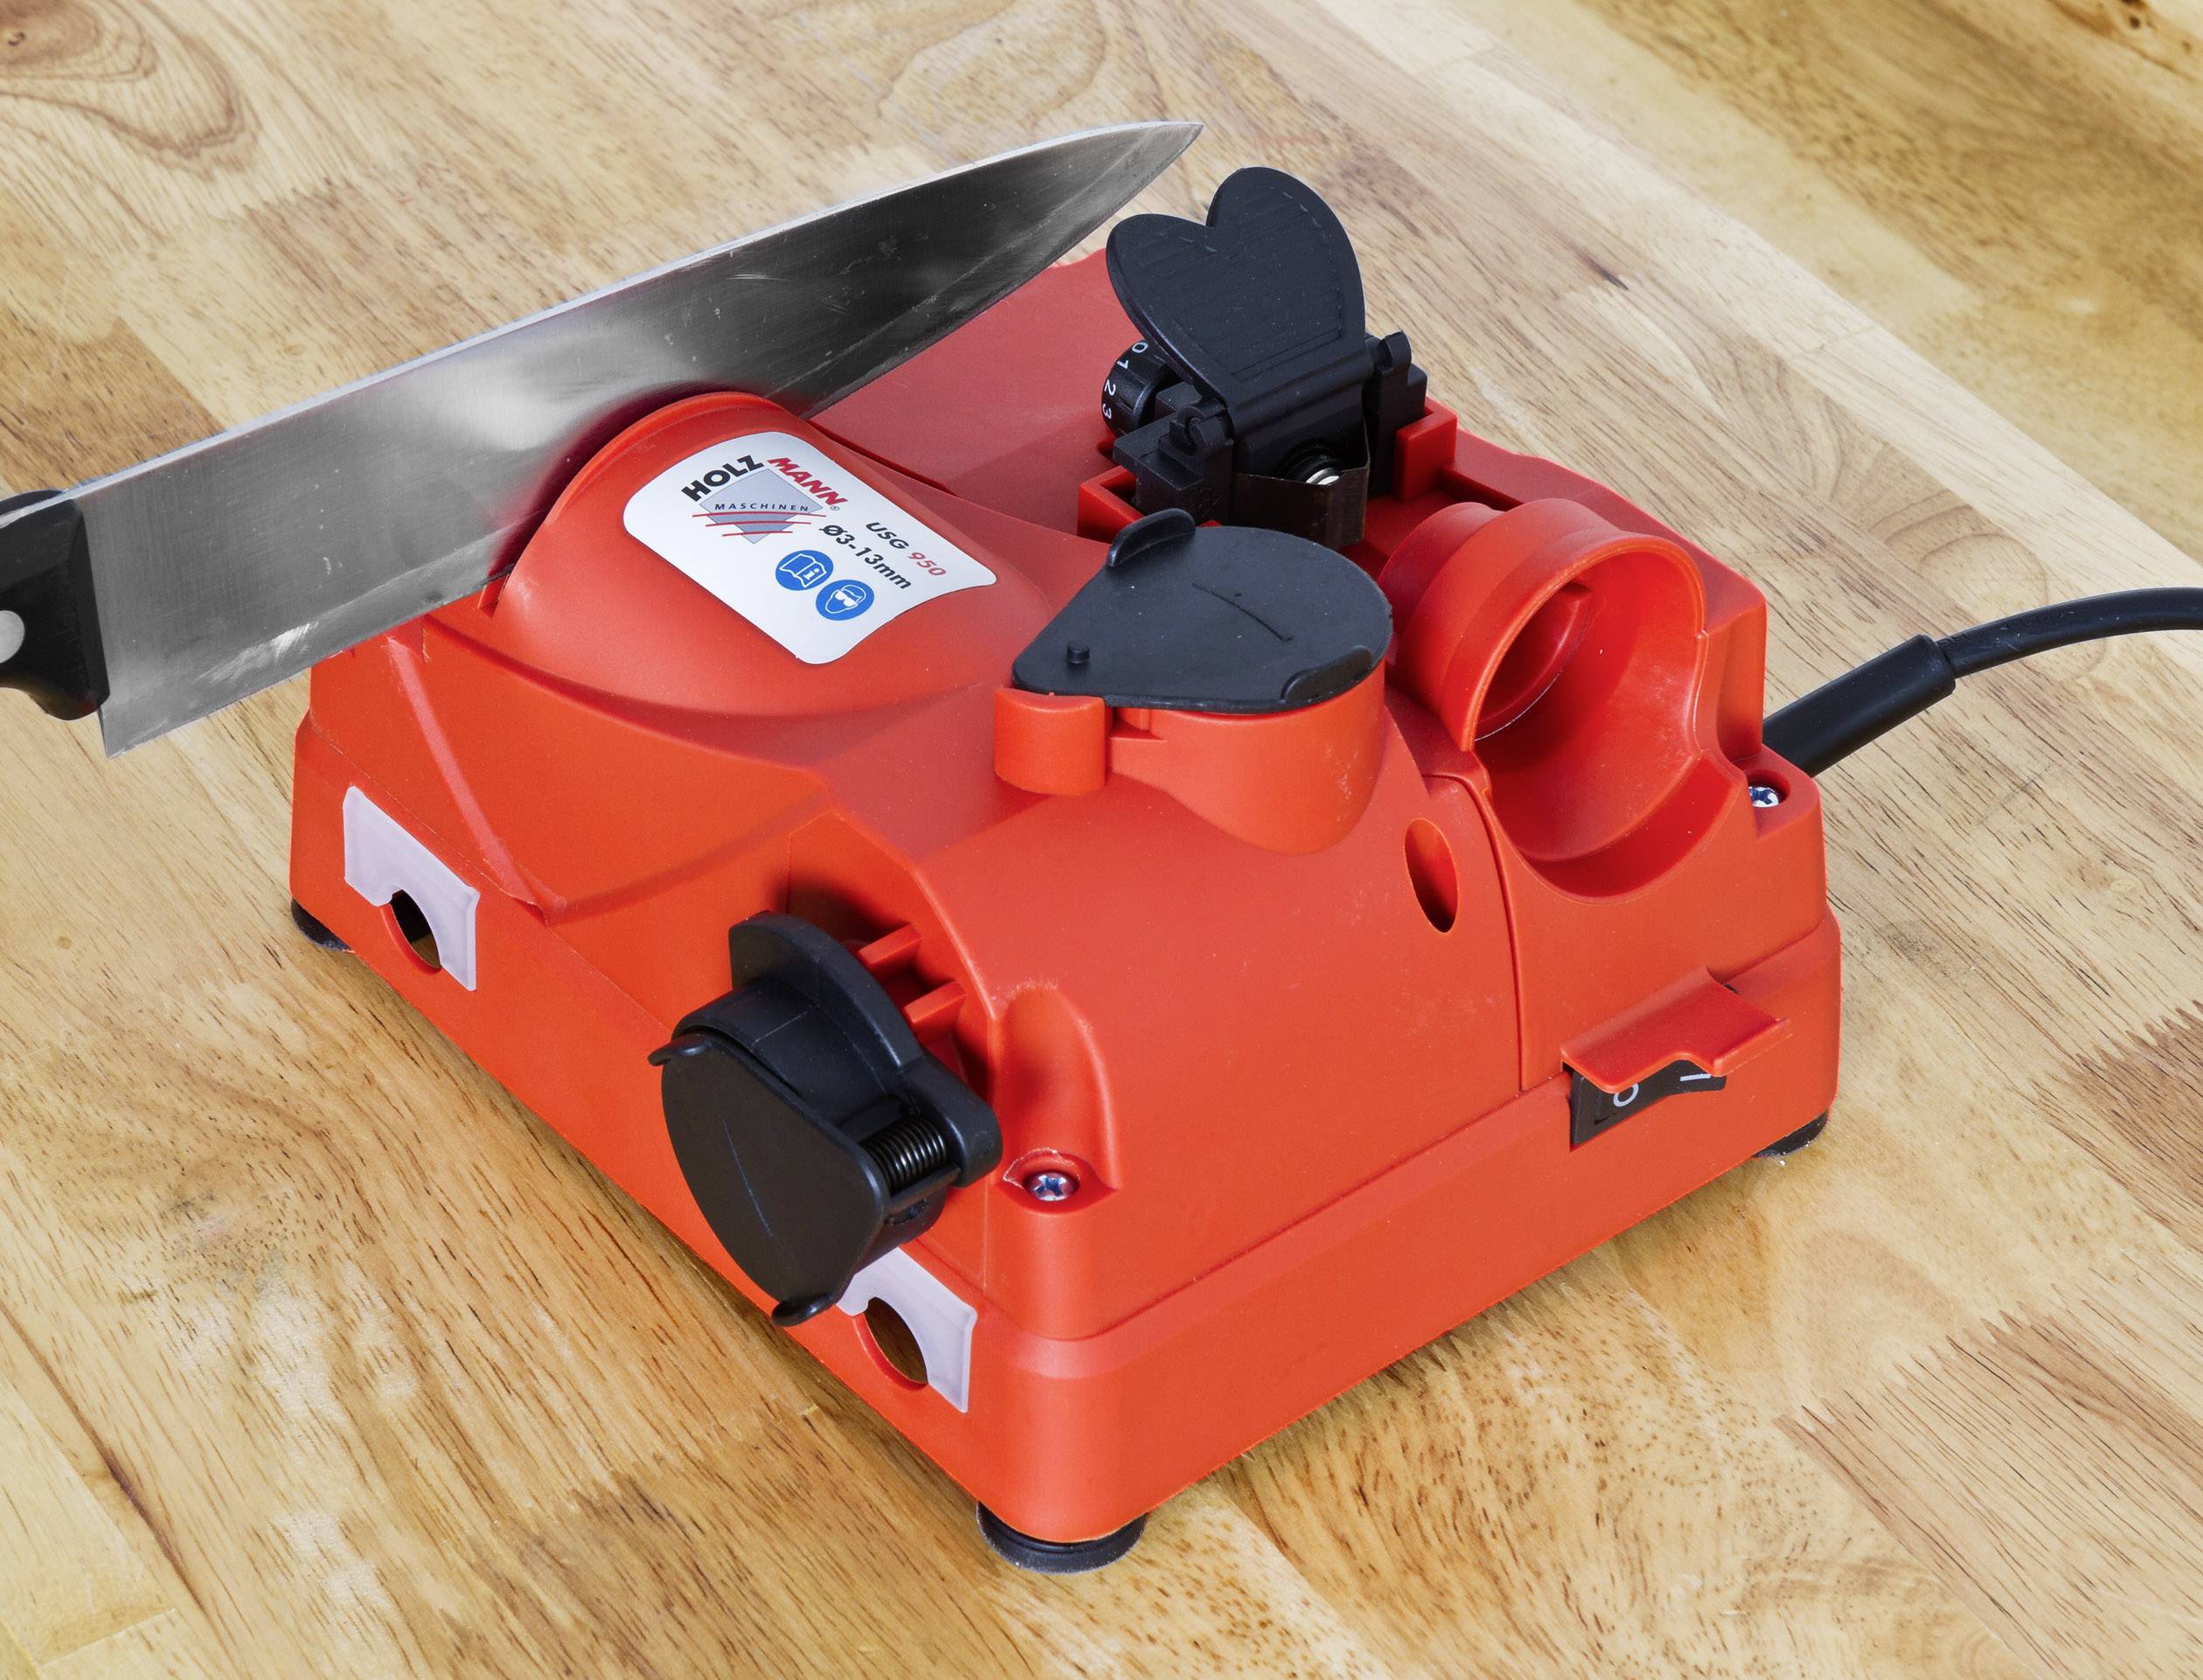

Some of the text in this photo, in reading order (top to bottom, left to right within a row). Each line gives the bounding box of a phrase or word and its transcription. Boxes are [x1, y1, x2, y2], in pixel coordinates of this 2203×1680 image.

[1117, 359, 1129, 369] 1
[1104, 379, 1115, 395] 2
[1102, 404, 1112, 420] 3
[714, 503, 809, 512] MASCHINEN
[818, 524, 912, 590] Ø3-13mm
[865, 522, 946, 577] USG 950
